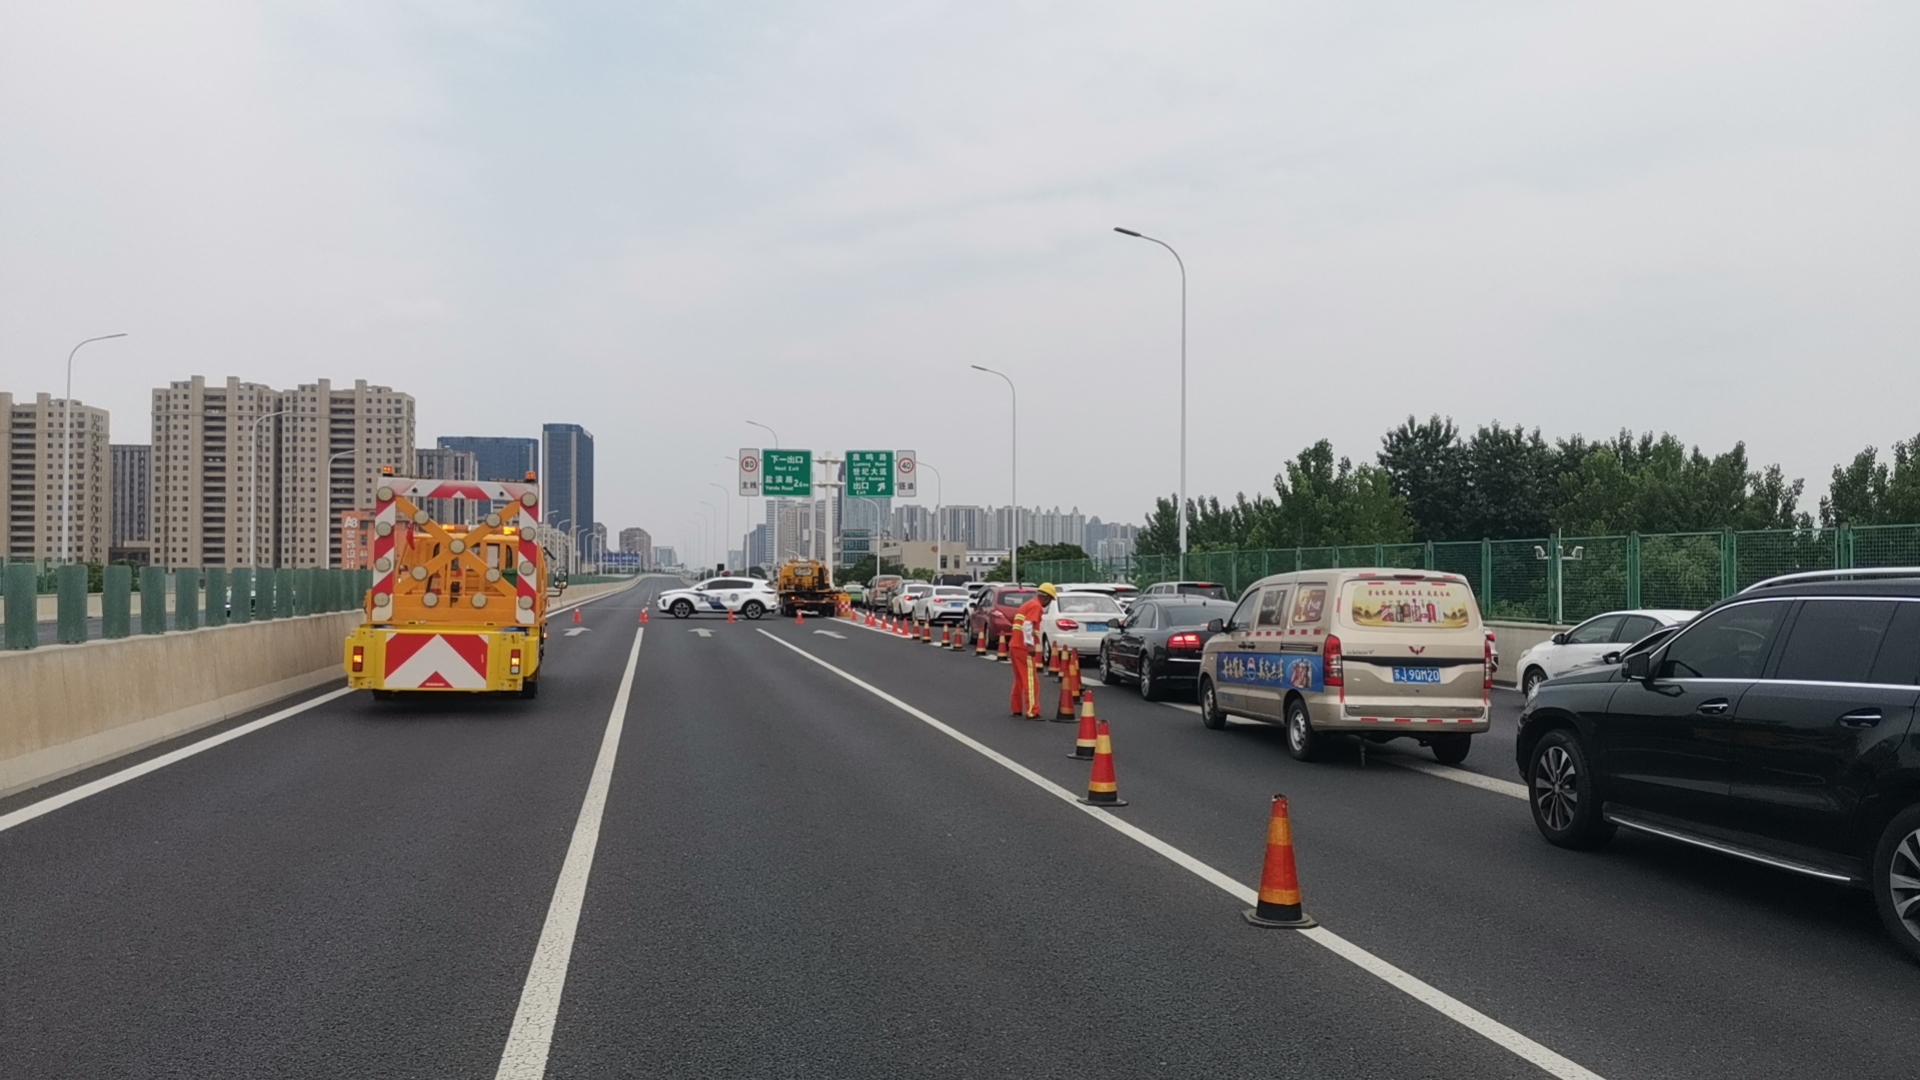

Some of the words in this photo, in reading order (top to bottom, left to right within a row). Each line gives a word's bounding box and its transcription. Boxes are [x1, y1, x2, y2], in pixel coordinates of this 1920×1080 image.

[770, 455, 803, 464] 下一出口
[744, 460, 755, 468] 80
[853, 482, 869, 490] 出口
